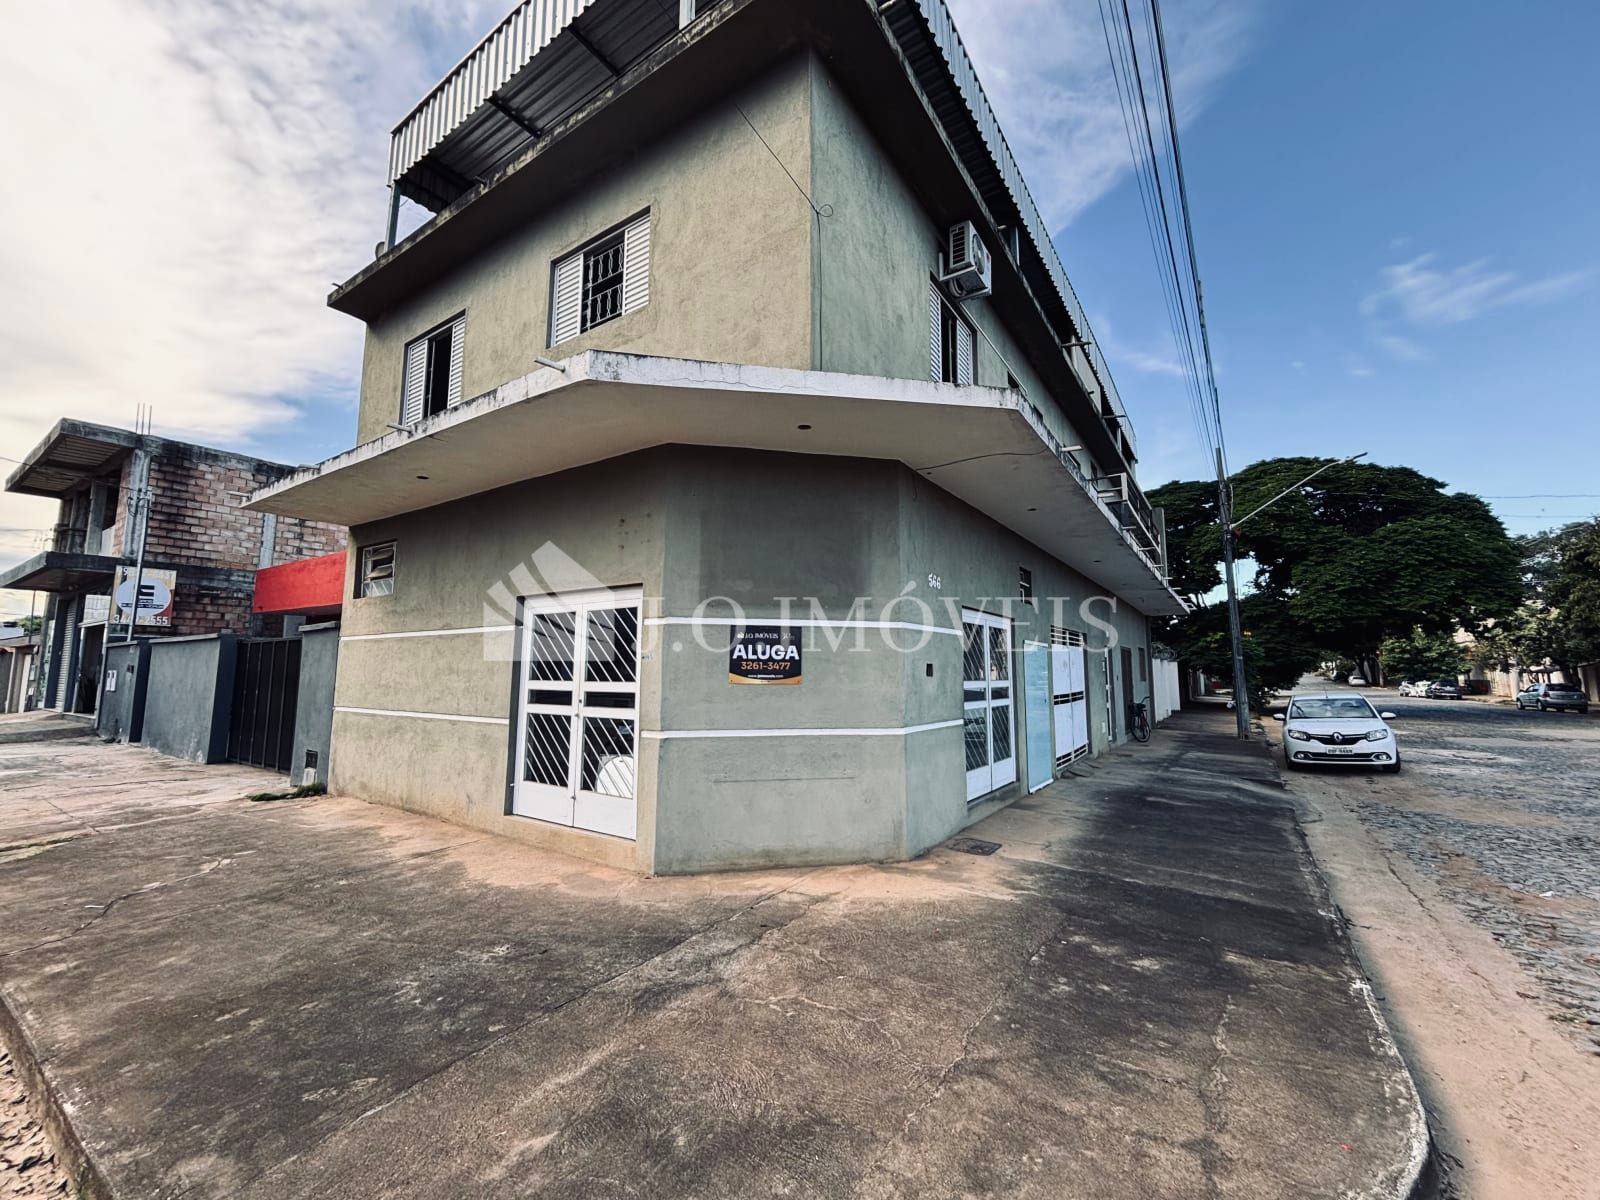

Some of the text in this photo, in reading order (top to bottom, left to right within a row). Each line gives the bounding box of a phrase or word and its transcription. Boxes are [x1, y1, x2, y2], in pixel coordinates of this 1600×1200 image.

[928, 573, 941, 590] 566
[732, 644, 800, 660] ALUGA
[740, 661, 791, 670] 3261-3477
